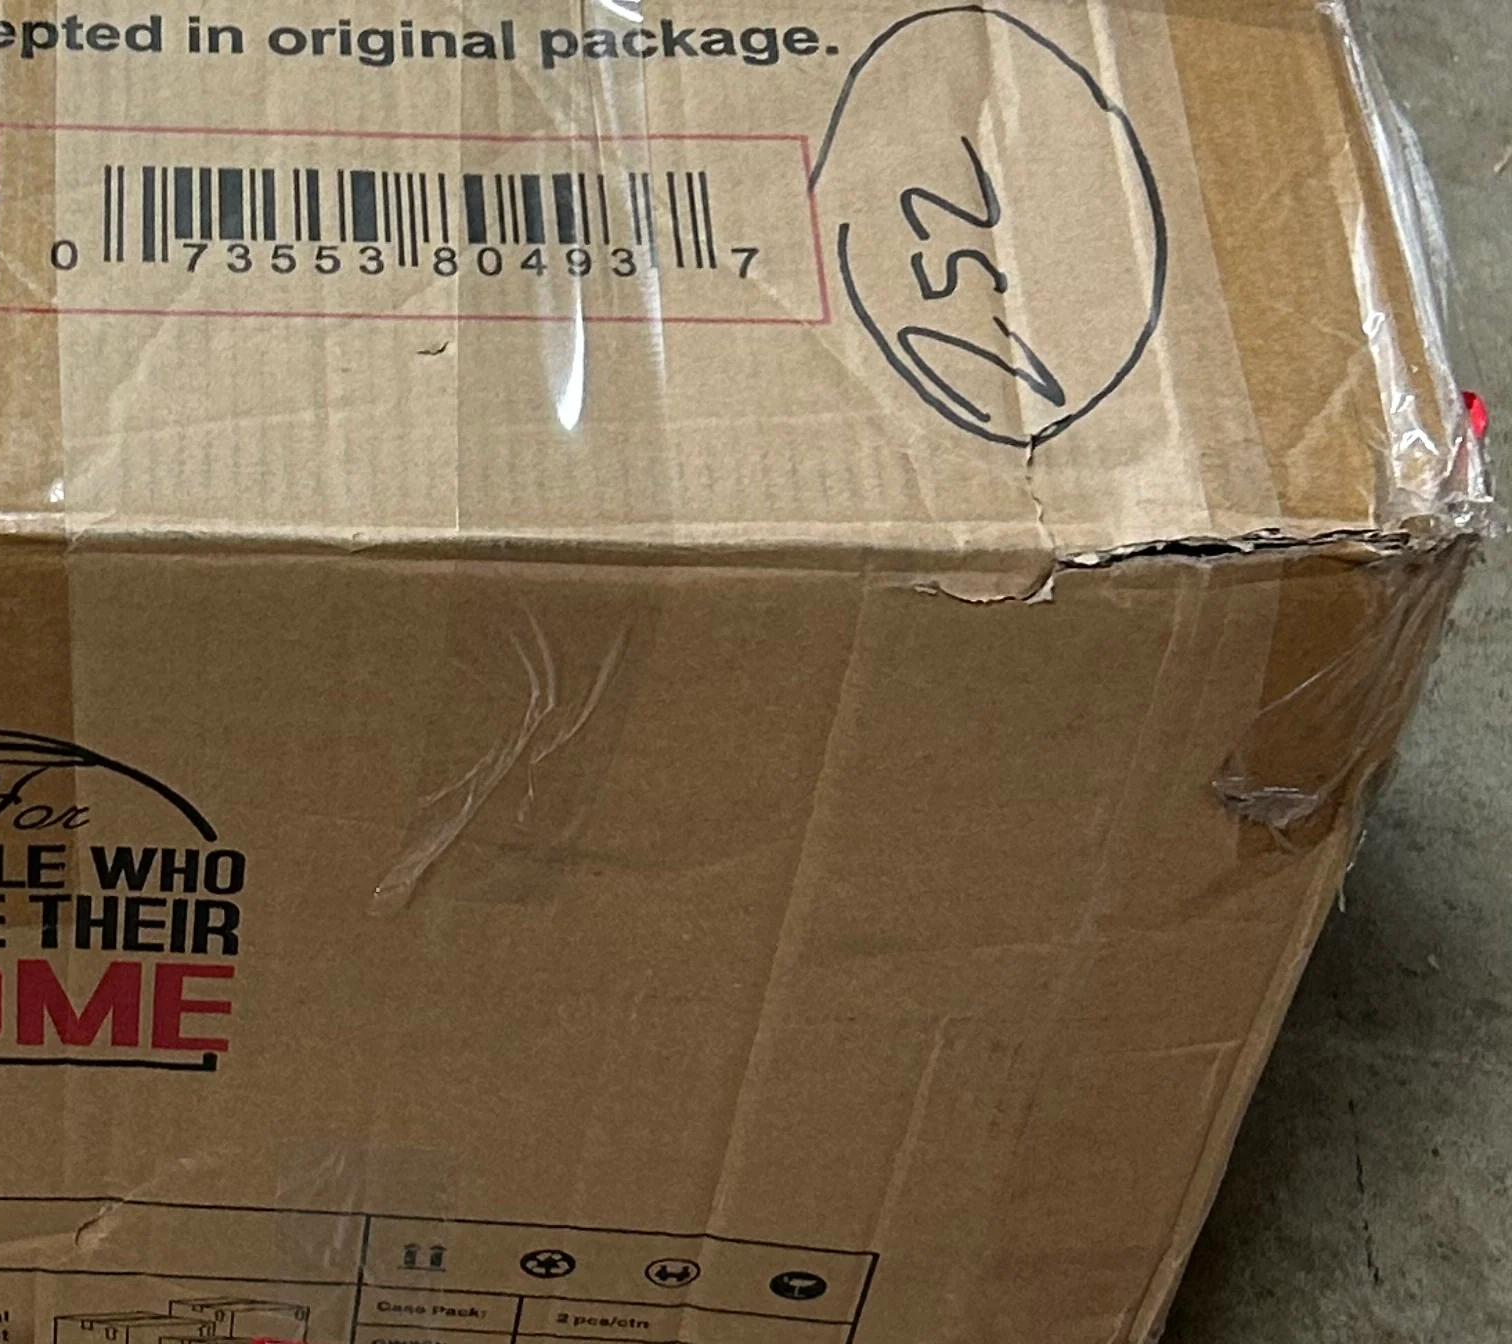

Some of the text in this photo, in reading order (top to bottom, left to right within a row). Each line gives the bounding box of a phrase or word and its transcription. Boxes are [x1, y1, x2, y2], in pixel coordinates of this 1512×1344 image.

[186, 16, 244, 54] in
[268, 19, 518, 66] original
[539, 19, 839, 67] package.
[90, 846, 247, 895] WHO
[28, 893, 241, 956] THEIR
[556, 1312, 570, 1325] 2
